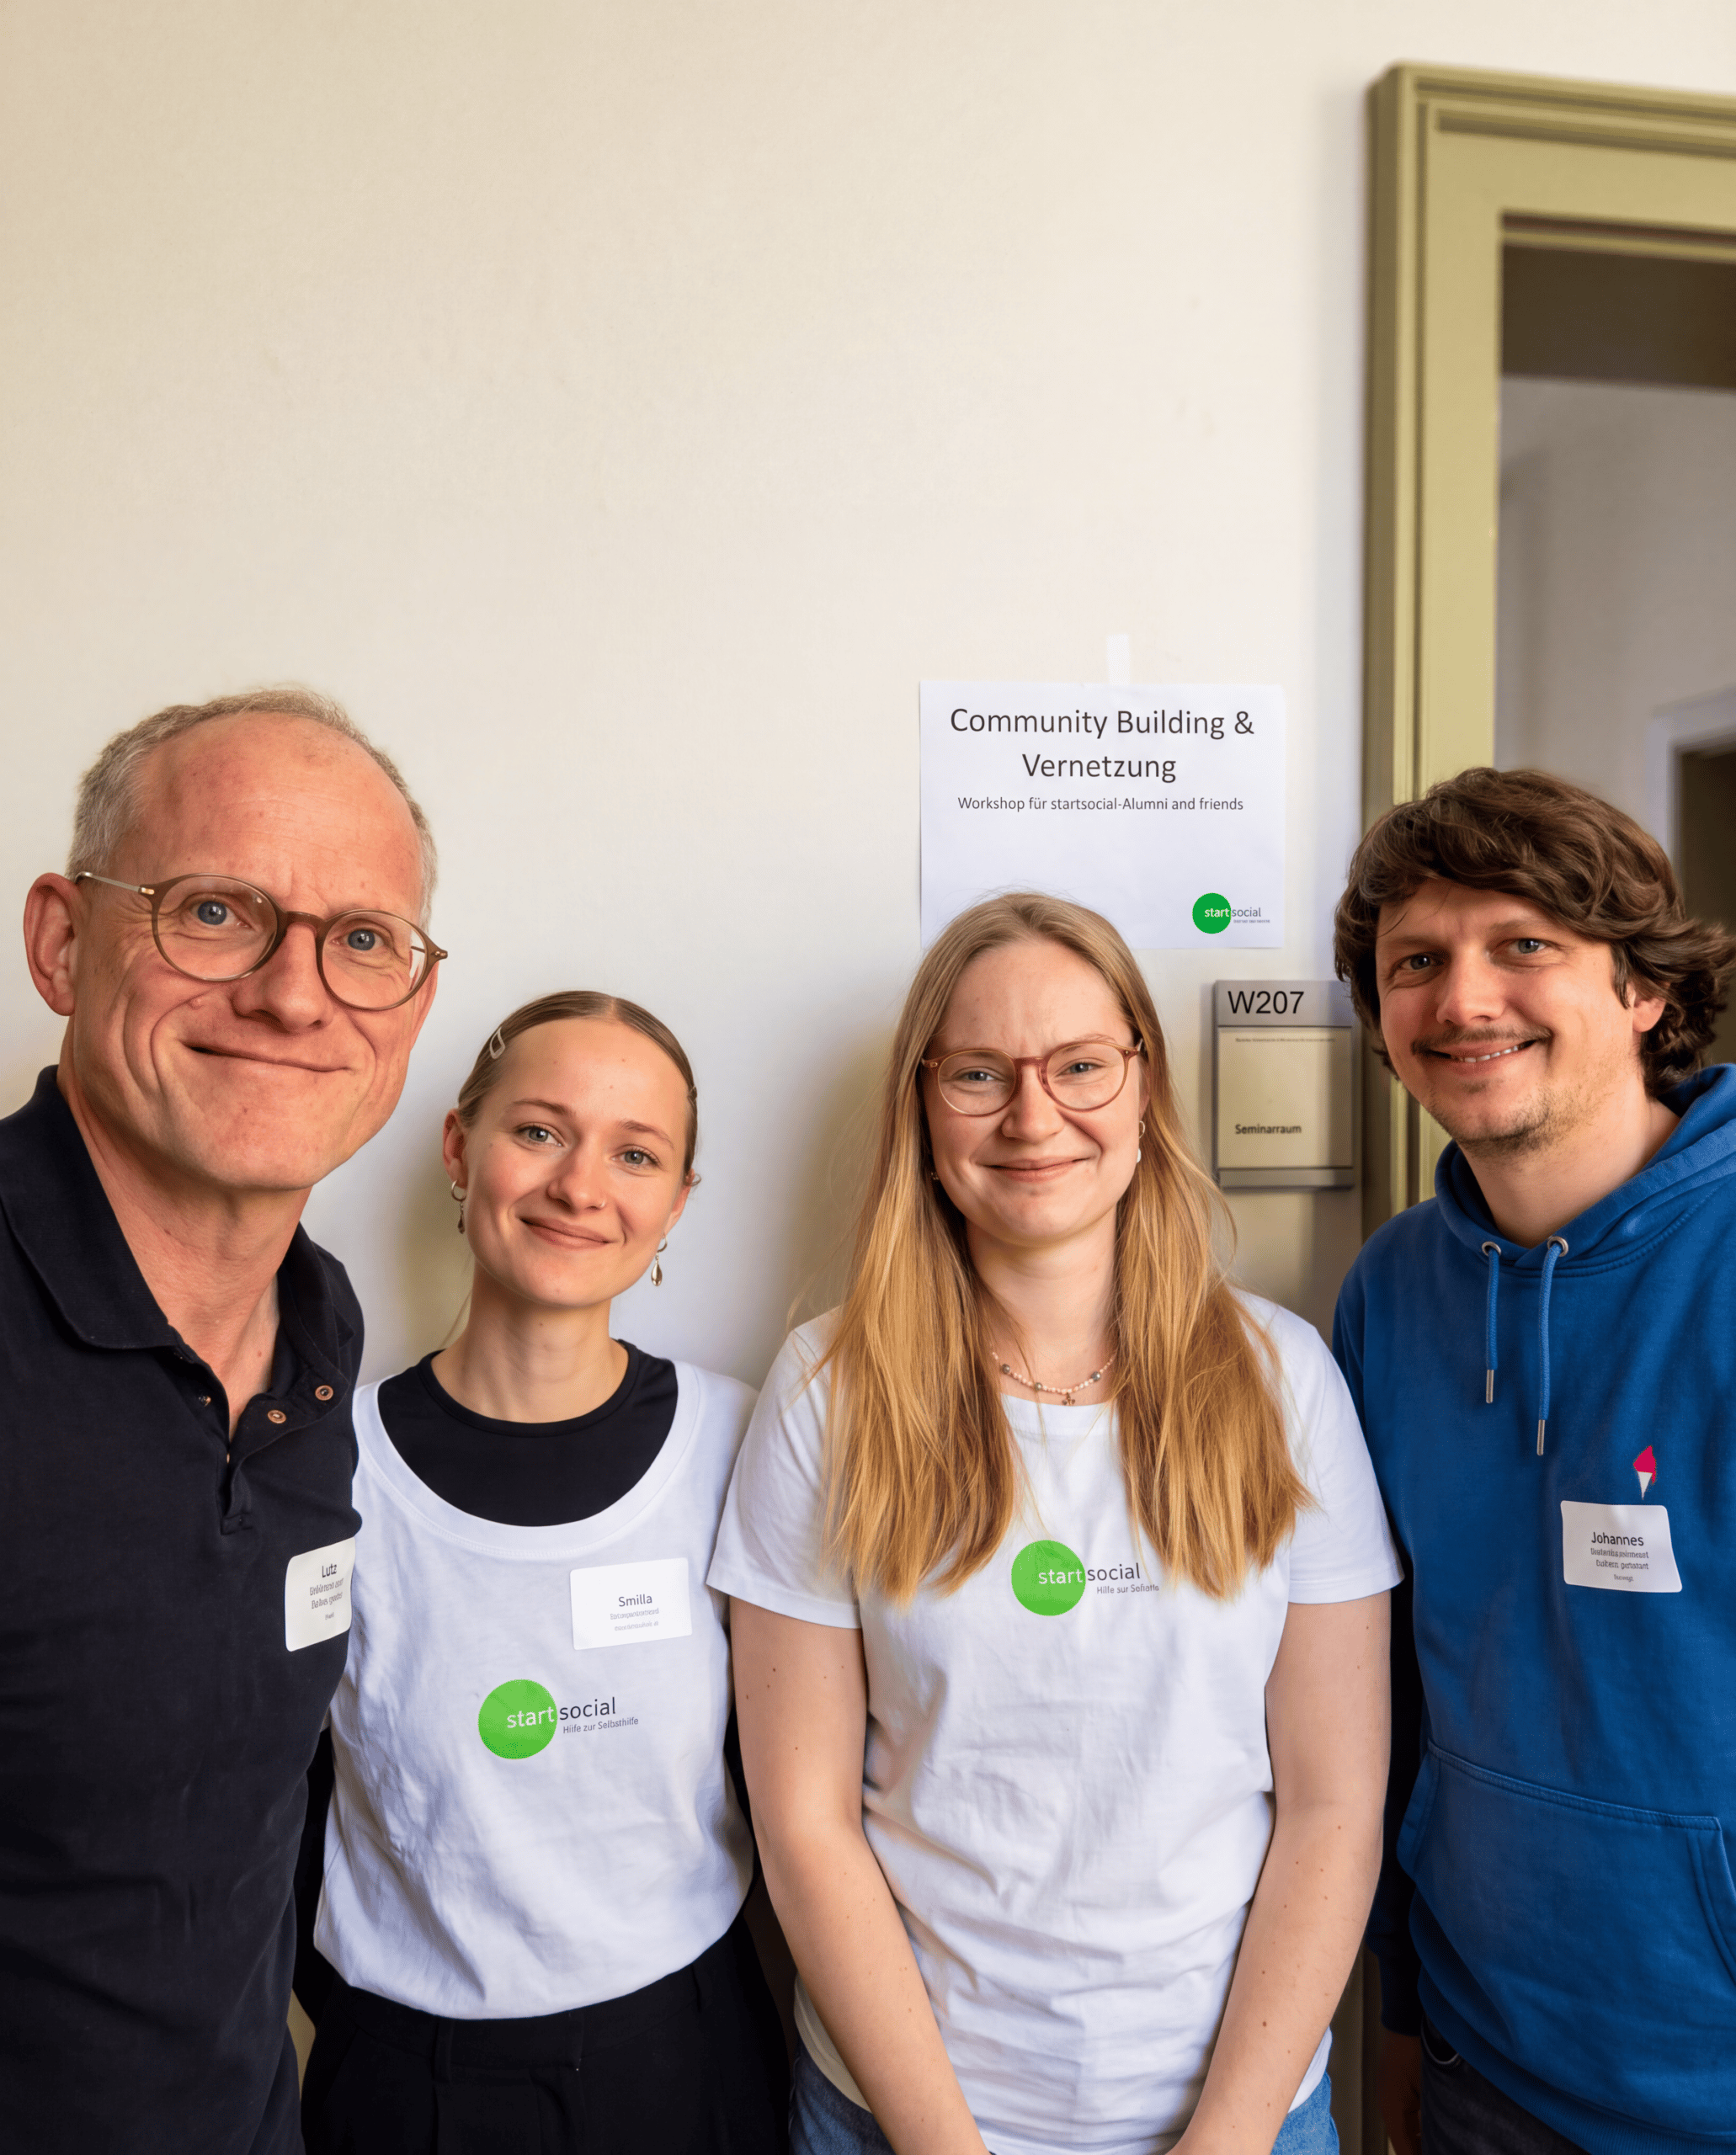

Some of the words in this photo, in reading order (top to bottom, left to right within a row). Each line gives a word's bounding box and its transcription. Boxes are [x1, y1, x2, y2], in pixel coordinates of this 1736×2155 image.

[950, 708, 1108, 739] Community
[1117, 710, 1225, 740] Building
[1234, 710, 1255, 735] &
[1022, 753, 1177, 783] Vernetzung
[957, 796, 1025, 811] Workshop
[1028, 796, 1047, 810] für
[1051, 796, 1169, 811] startsocial-Alumni
[1171, 797, 1195, 810] and
[1199, 797, 1243, 811] friends
[1227, 991, 1304, 1014] W207
[1234, 1123, 1302, 1136] Seminarraum
[1591, 1531, 1644, 1546] Johannes
[322, 1563, 338, 1578] Lutz
[618, 1594, 653, 1607] Smilla
[583, 1722, 596, 1732] zur
[598, 1716, 639, 1731] Selbsthilfe
